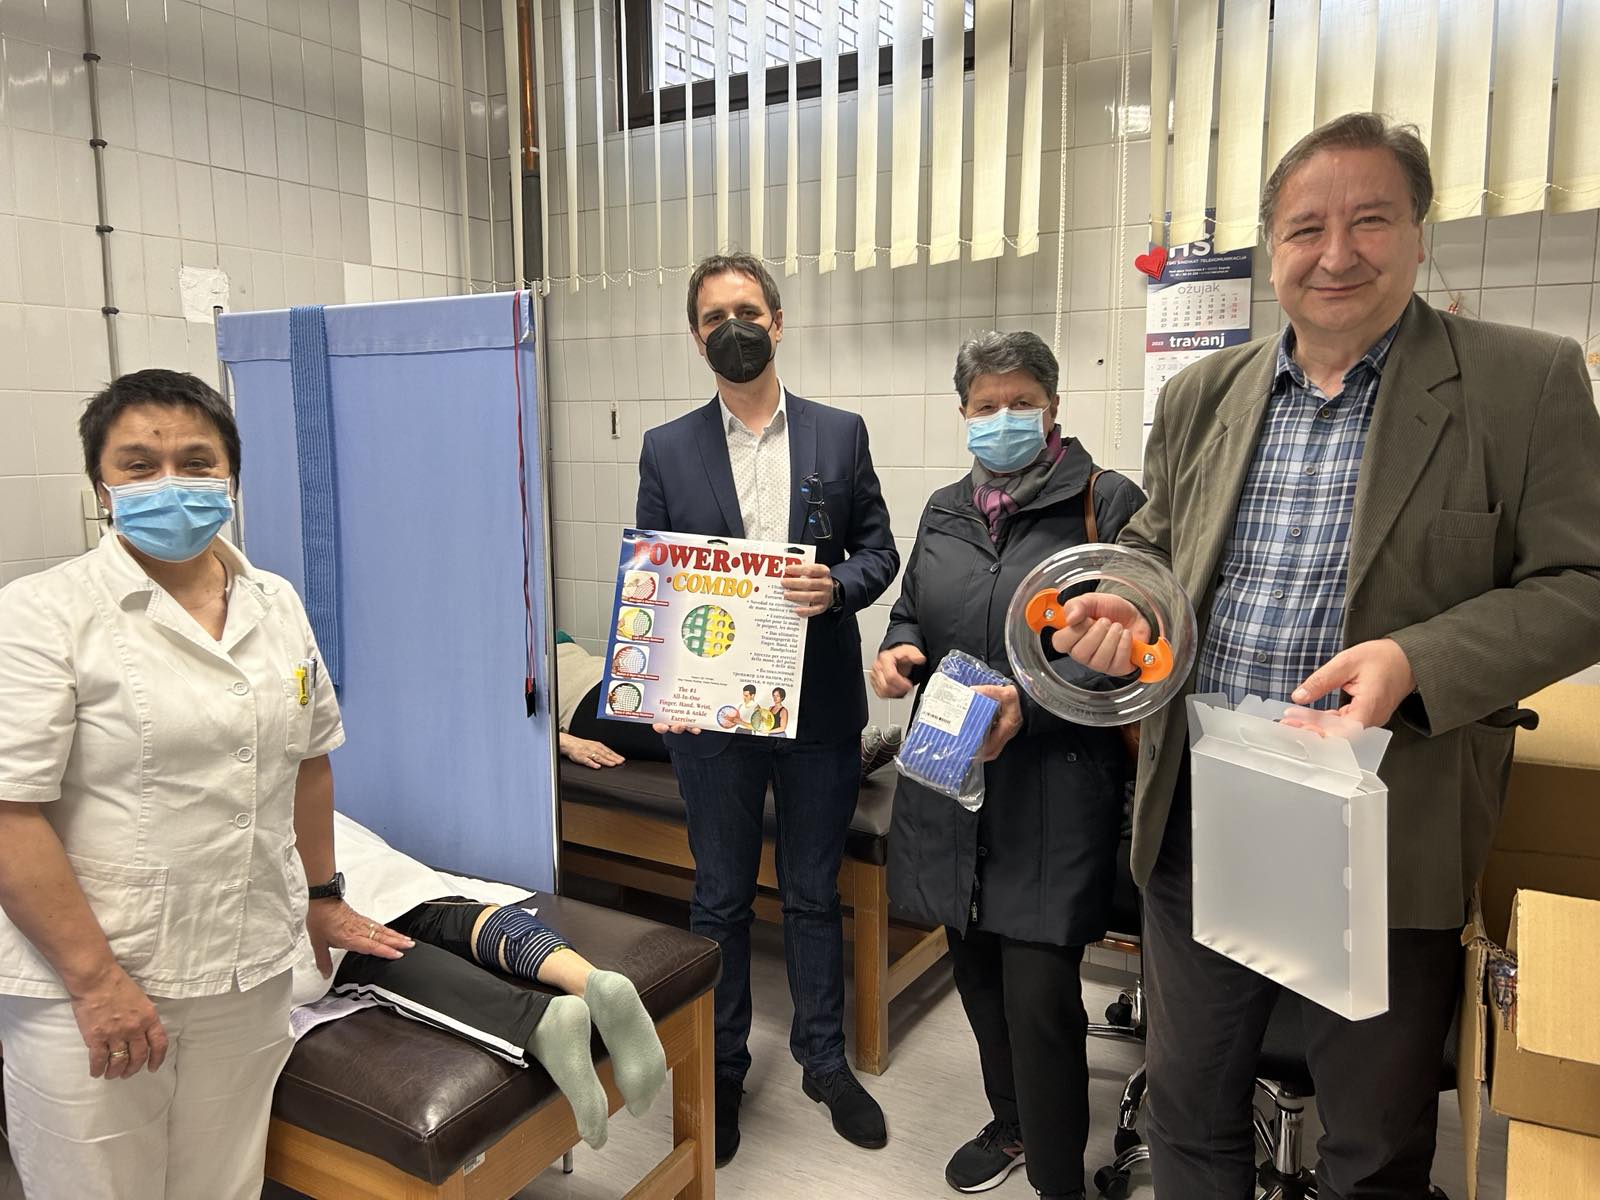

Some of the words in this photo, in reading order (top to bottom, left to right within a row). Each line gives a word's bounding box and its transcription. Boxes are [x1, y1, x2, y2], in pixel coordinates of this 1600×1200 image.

[1178, 283, 1220, 295] ožujak
[1170, 333, 1225, 347] travanj
[672, 572, 753, 598] COMBO
